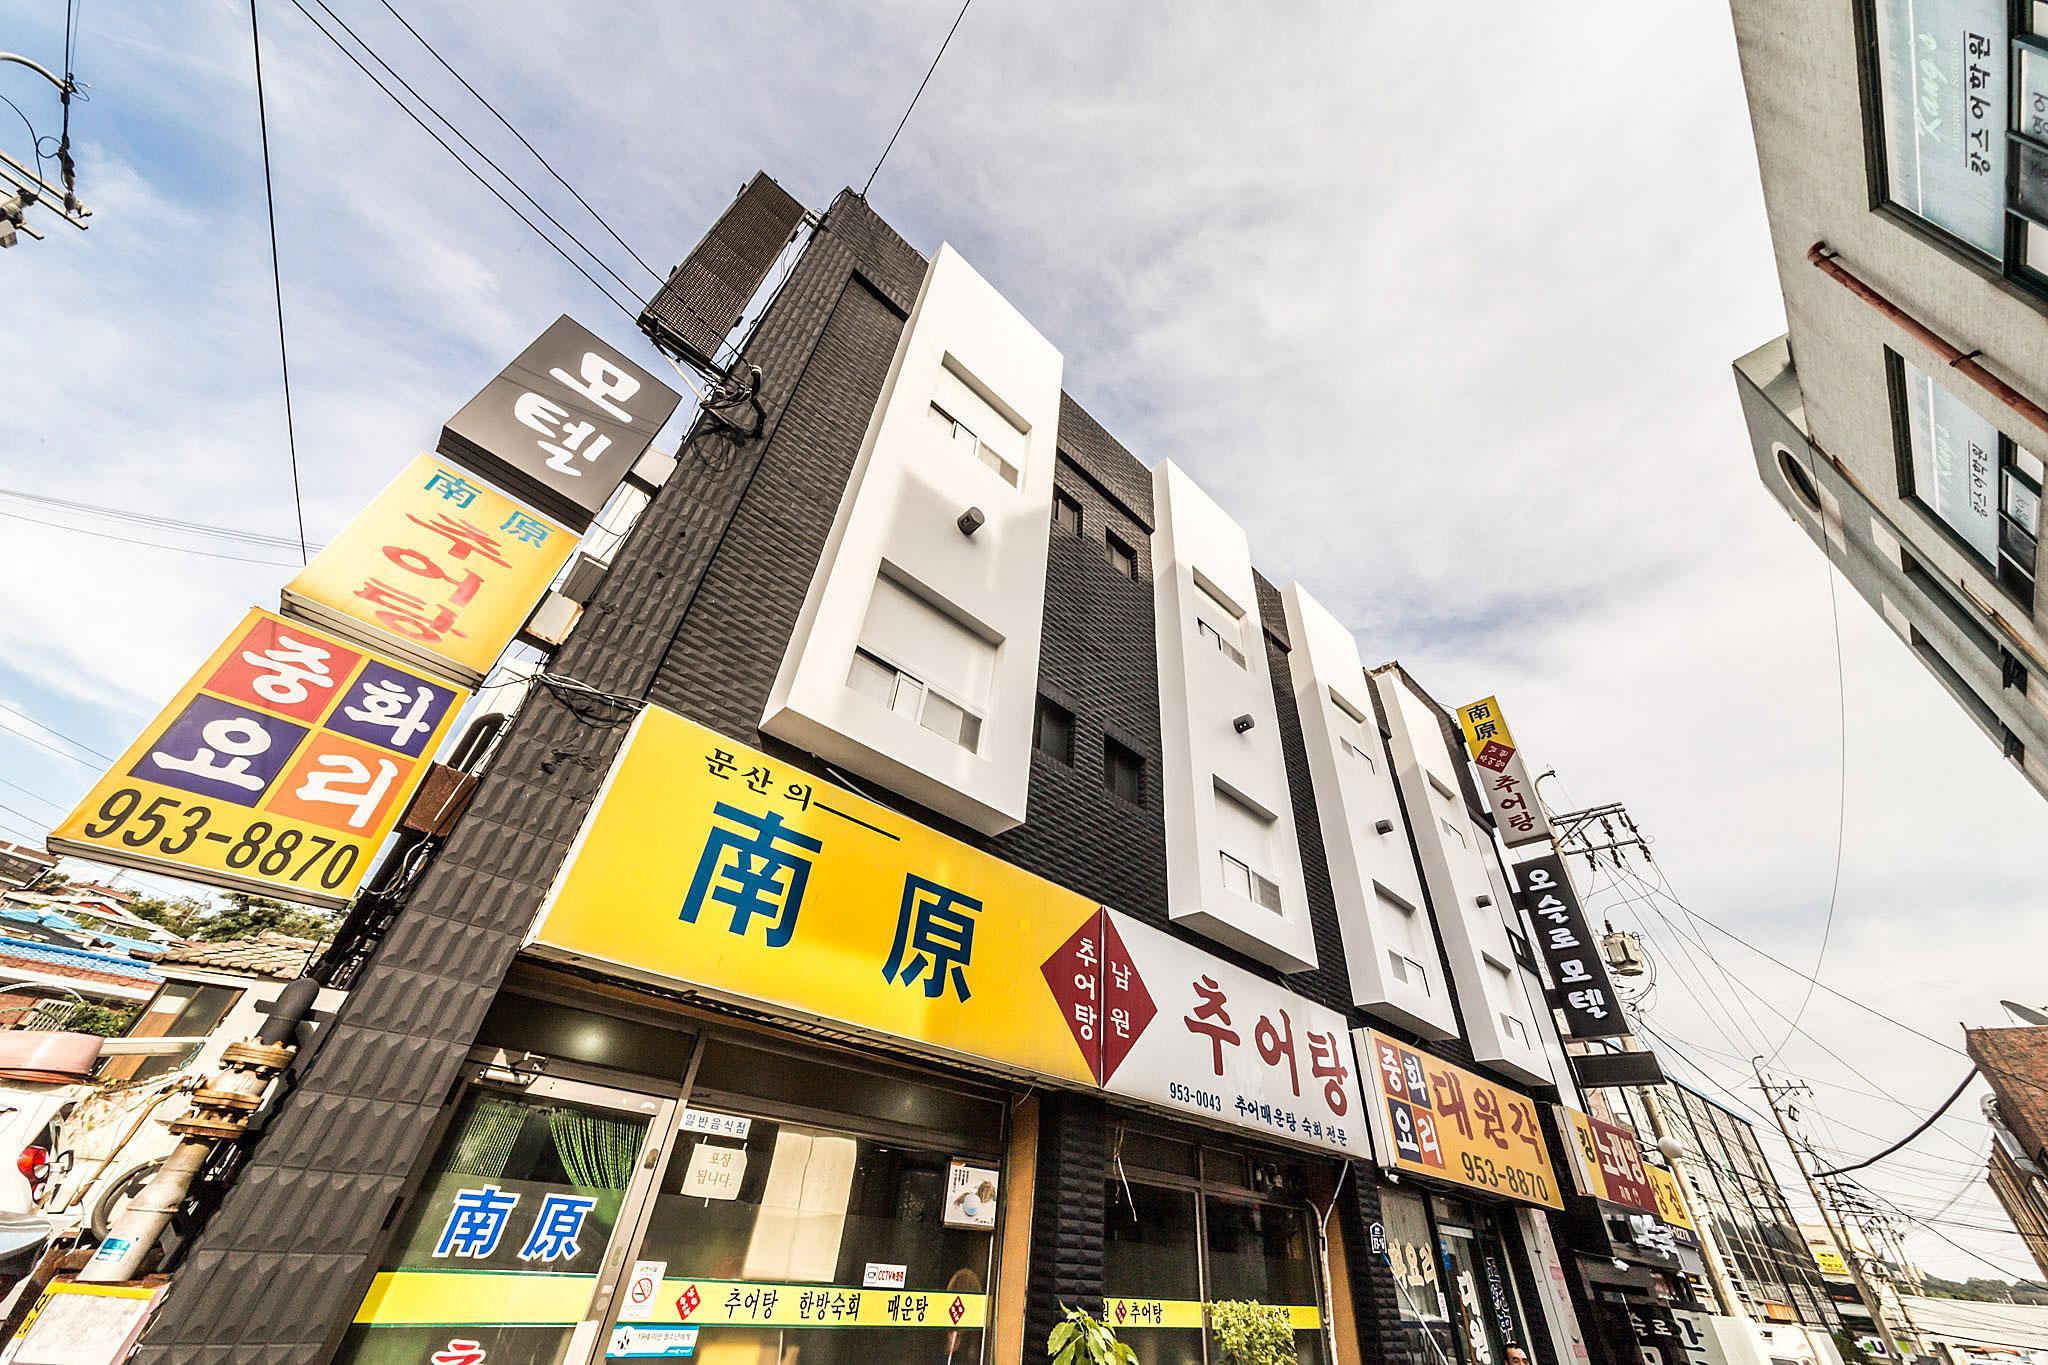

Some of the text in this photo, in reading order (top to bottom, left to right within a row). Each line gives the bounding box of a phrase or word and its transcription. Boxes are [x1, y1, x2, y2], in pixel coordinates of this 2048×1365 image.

[1968, 32, 1992, 176] 캉스어학원
[514, 351, 641, 477] 모텔
[422, 468, 557, 549] 南原
[352, 512, 514, 645] 추어탕
[241, 635, 434, 747] 중화
[1467, 703, 1499, 741] 南原
[151, 716, 398, 829] 요리
[1493, 775, 1536, 832] 추어탕
[85, 787, 361, 891] 953-8870
[678, 801, 984, 1003] 南原
[1075, 938, 1098, 1041] 추어탕
[1109, 961, 1133, 1039] 남원
[1184, 974, 1349, 1117] 추어탕
[1379, 1046, 1429, 1103] 중화
[685, 1112, 747, 1136] 일반음식점
[1169, 1082, 1348, 1147] 953-0043 추어매운탕 숙회 전문
[1395, 1105, 1443, 1166] 요리
[1429, 1070, 1545, 1165] 대원각
[708, 1151, 732, 1167] 포장
[1461, 1151, 1550, 1201] 953-8870
[1592, 1126, 1646, 1185] 노래방
[432, 1184, 598, 1263] 南原
[724, 1289, 778, 1321] 추어탕
[800, 1291, 861, 1321] 한방숙회
[887, 1294, 929, 1322] 매운탕
[1130, 1301, 1163, 1324] 추어탕
